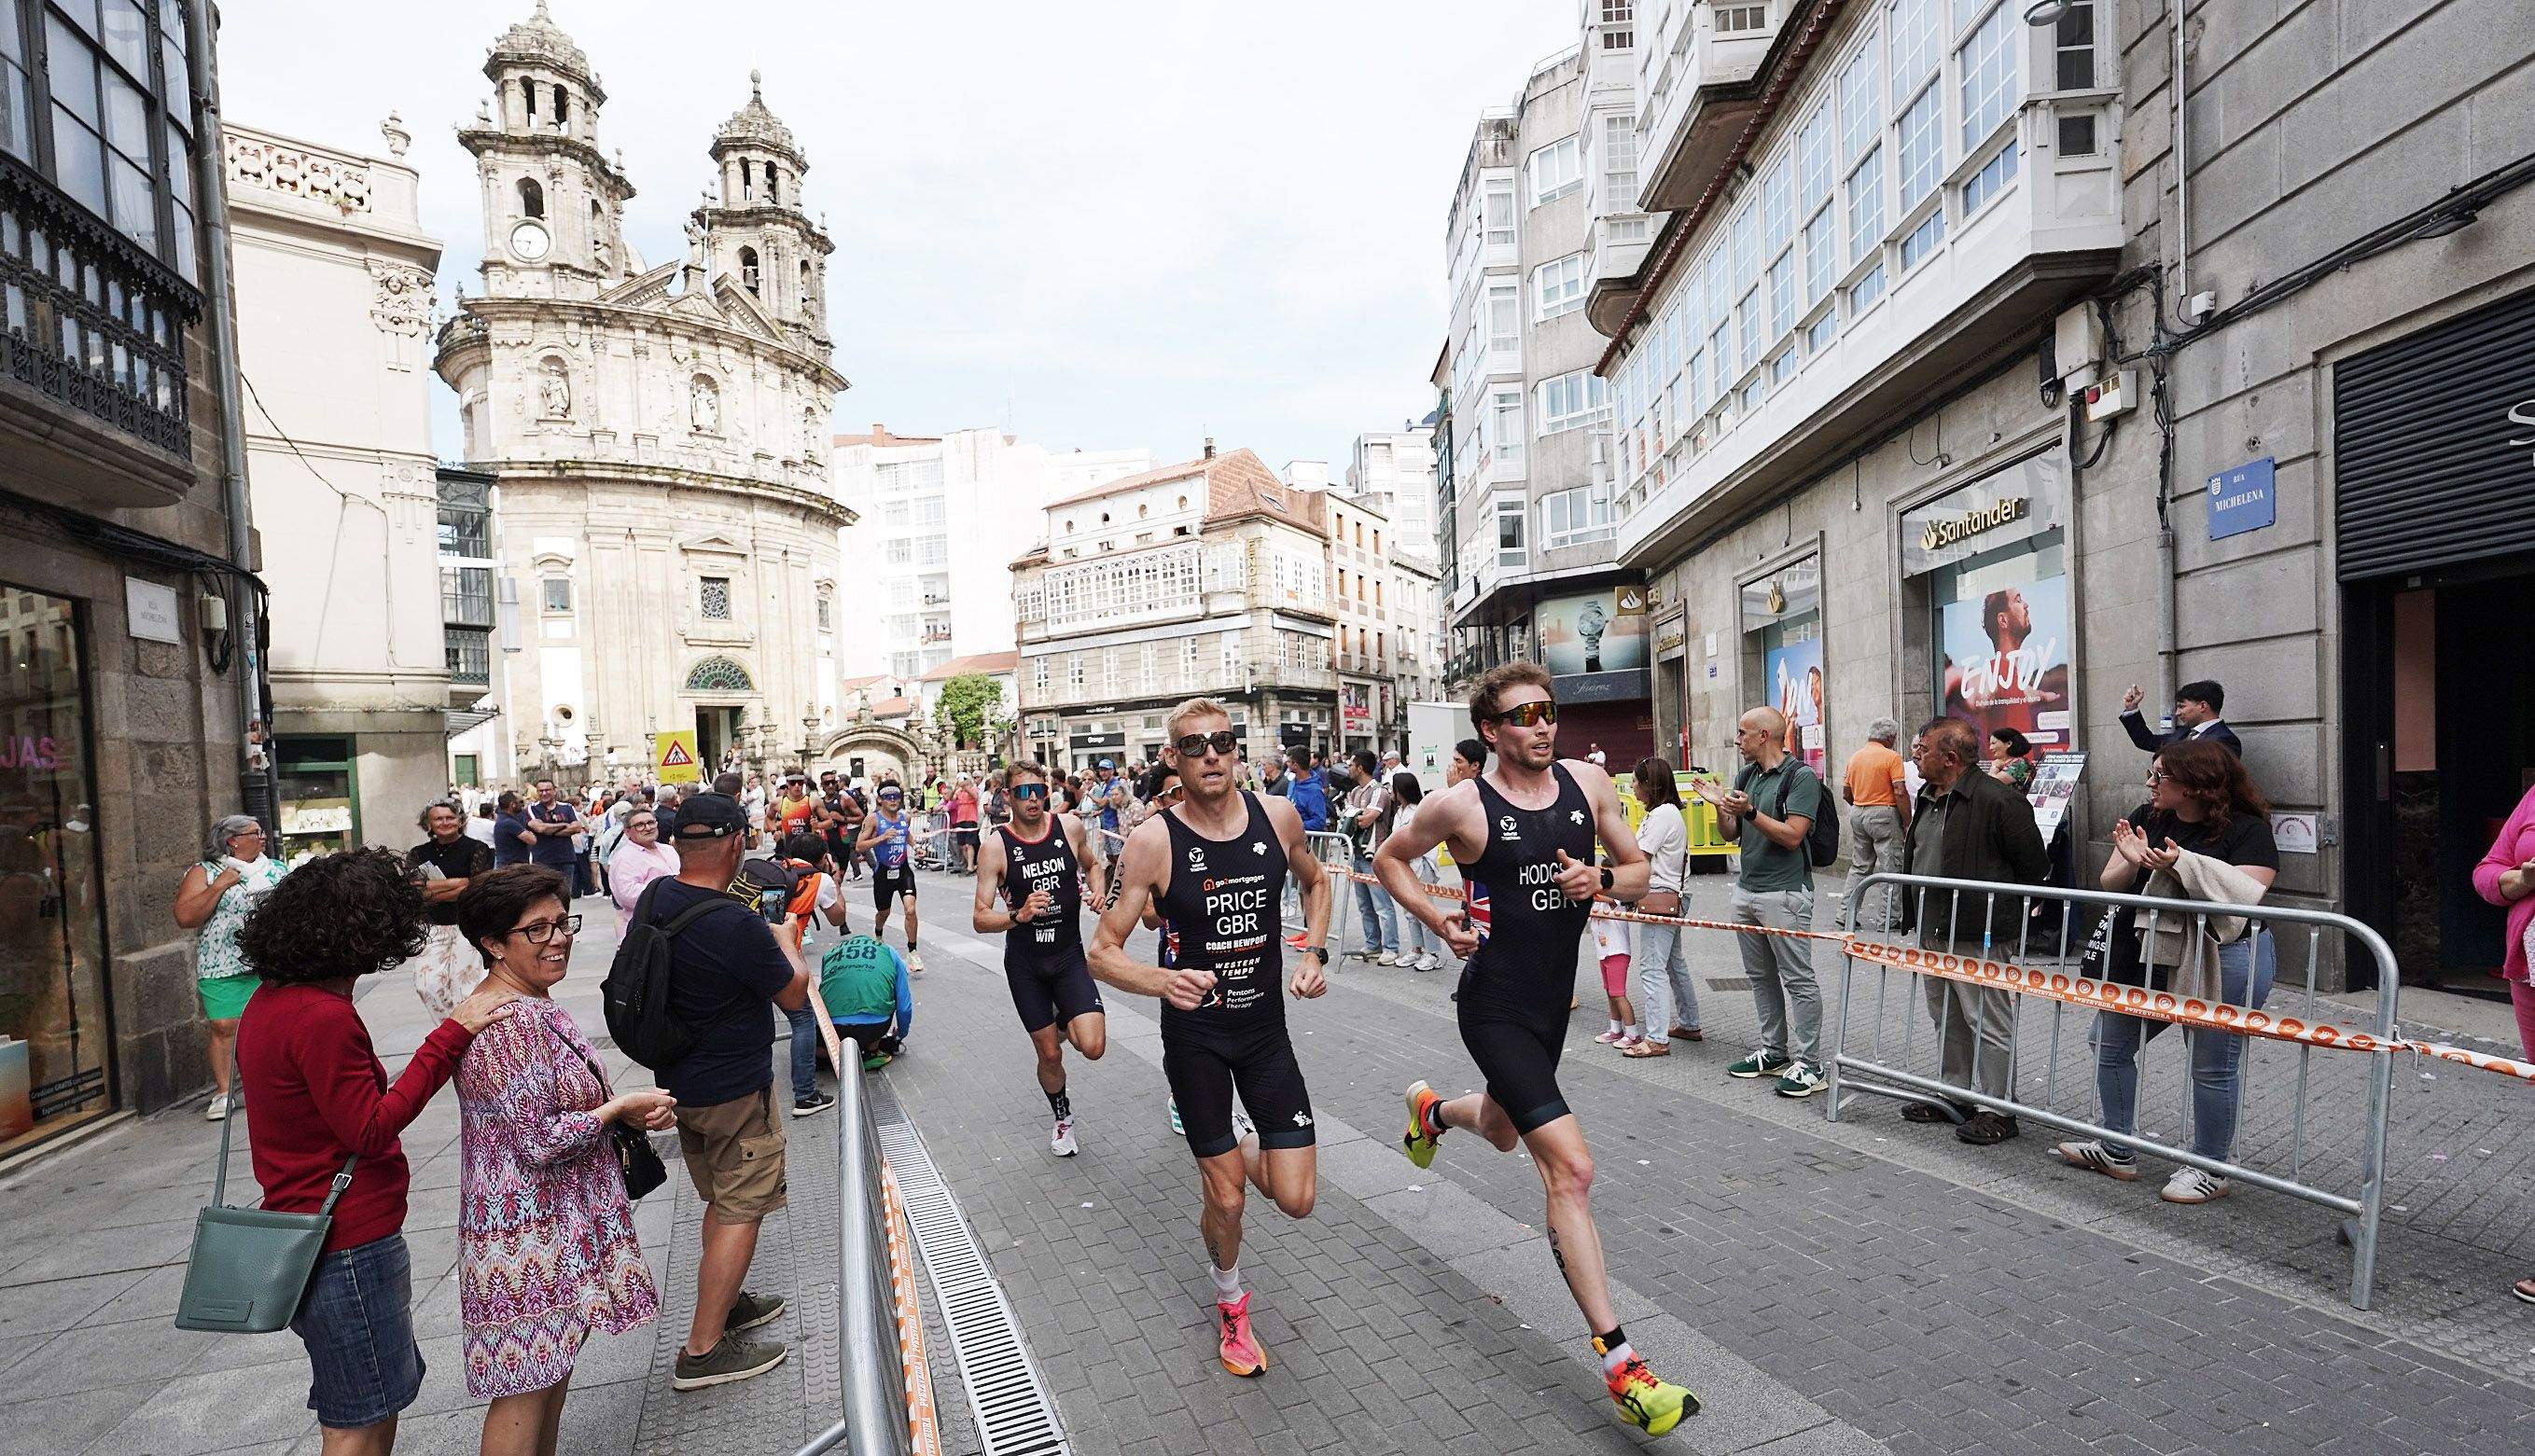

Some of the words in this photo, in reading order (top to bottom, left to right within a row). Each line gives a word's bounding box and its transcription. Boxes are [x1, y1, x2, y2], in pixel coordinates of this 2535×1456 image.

[2215, 489, 2264, 512] MICHELENA
[1939, 497, 2019, 546] Santander
[1960, 636, 2056, 700] ENJOY
[888, 844, 904, 854] JPN
[1022, 857, 1066, 880] NELSON
[1032, 875, 1061, 892] GBR
[1215, 875, 1265, 888] go2mortgages
[1205, 889, 1267, 916] PRICE
[1216, 912, 1258, 936] GBR
[1036, 932, 1055, 942] WIN
[1205, 940, 1233, 950] COACH
[1233, 934, 1268, 949] NEWPORT
[1215, 956, 1261, 969] WESTERN
[1222, 966, 1255, 977] TEMPO
[1226, 991, 1265, 1004] Performance
